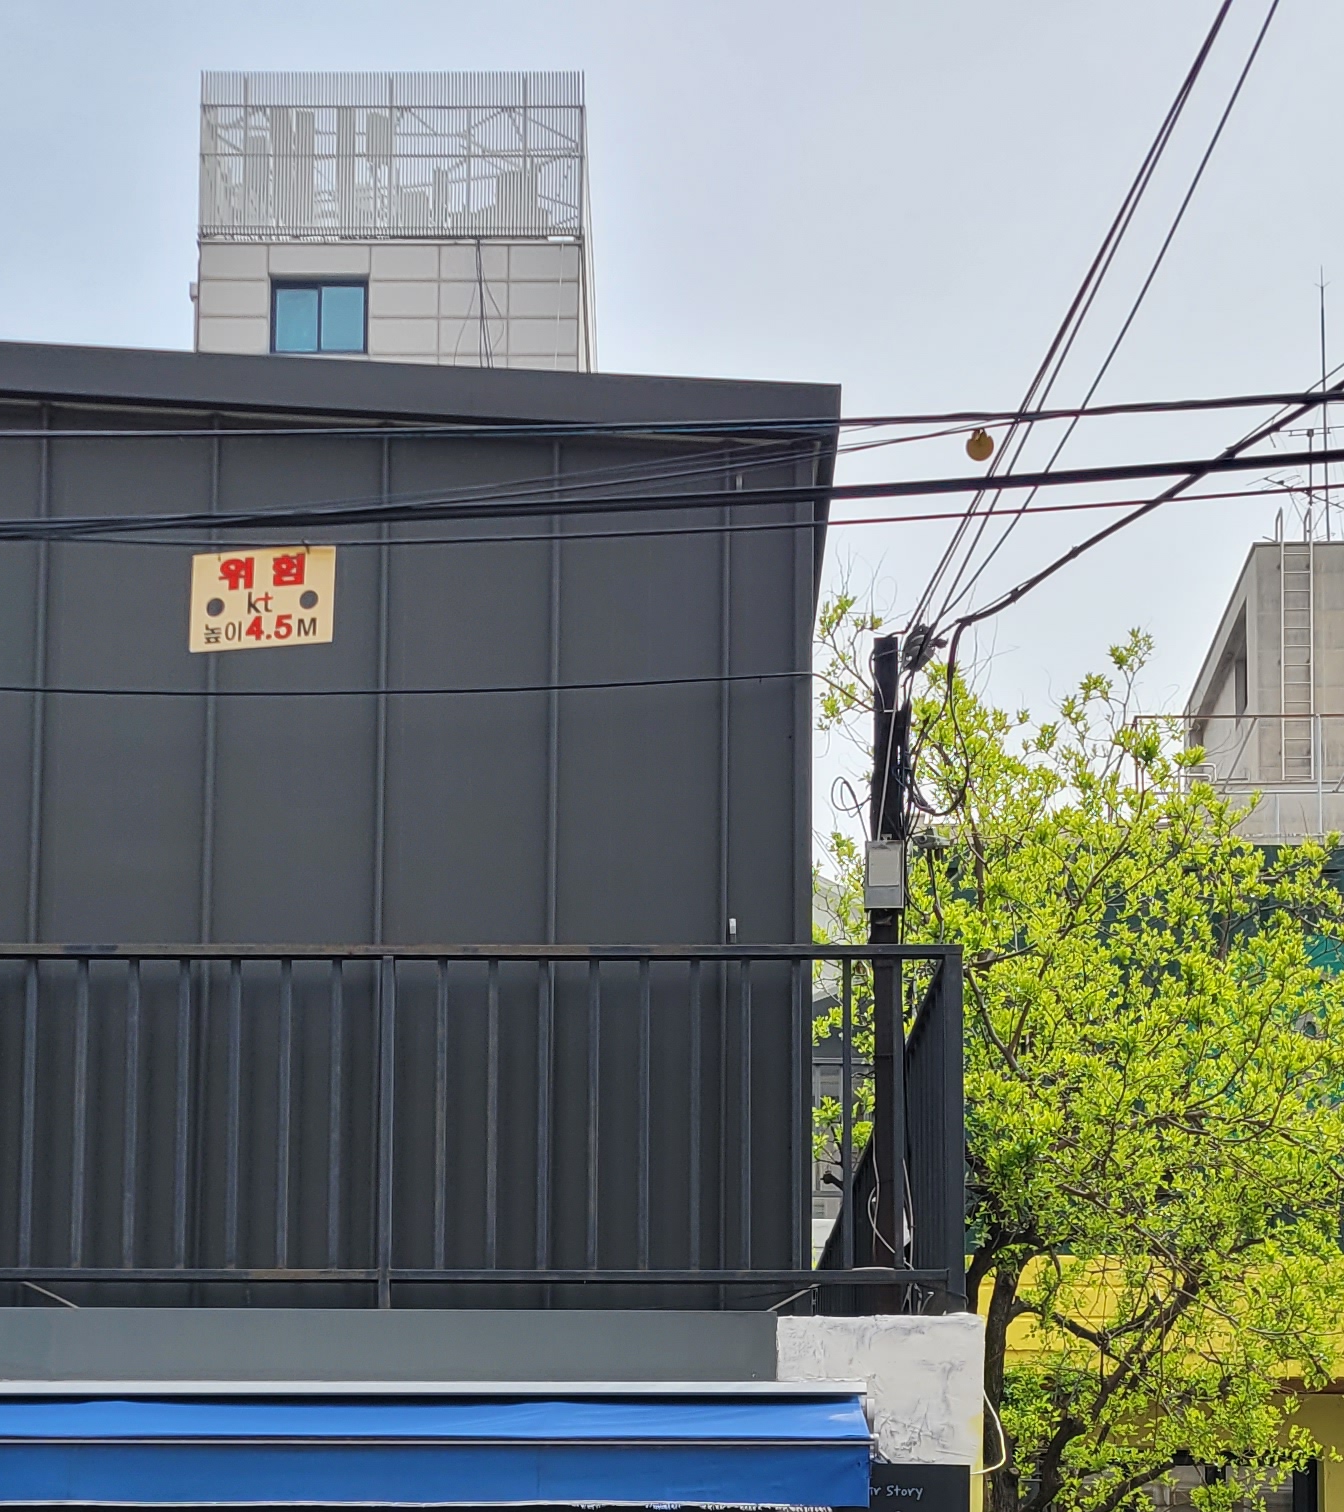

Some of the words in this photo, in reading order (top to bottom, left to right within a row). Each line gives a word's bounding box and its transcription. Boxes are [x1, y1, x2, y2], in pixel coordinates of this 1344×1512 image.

[218, 552, 306, 590] 위험
[247, 591, 273, 614] kt
[204, 620, 243, 645] 높이
[886, 1485, 923, 1500] Story
